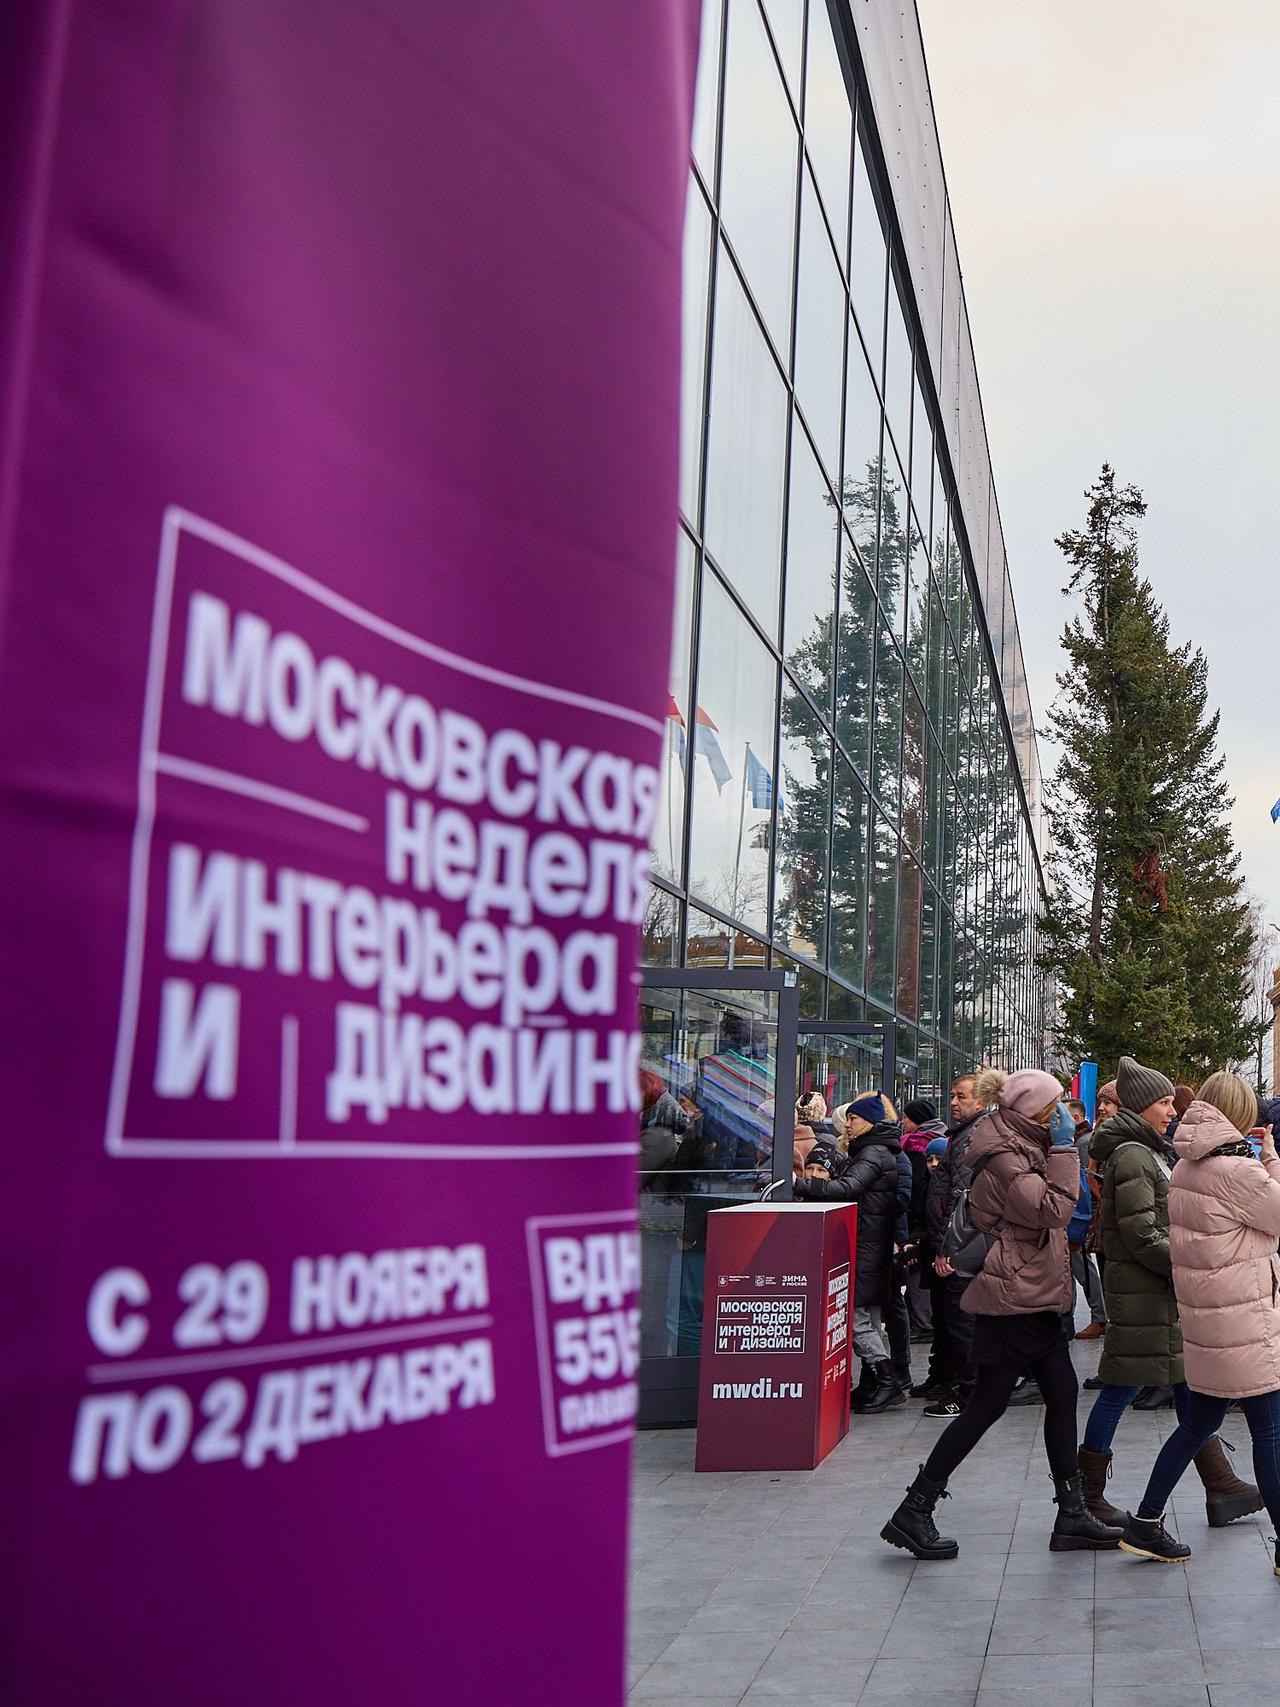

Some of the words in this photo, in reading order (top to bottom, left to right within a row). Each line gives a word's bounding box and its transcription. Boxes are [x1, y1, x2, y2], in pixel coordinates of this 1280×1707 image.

[164, 843, 619, 1030] интерьера
[782, 1275, 808, 1283] ЗИМА
[86, 1265, 151, 1358] С
[172, 1259, 270, 1350] 29
[289, 1243, 489, 1335] НОЯБРЯ
[720, 1301, 803, 1313] московская
[752, 1312, 803, 1326] неделя
[719, 1325, 791, 1338] интерьера
[718, 1337, 728, 1349] и
[740, 1336, 801, 1350] дизайна
[712, 1377, 803, 1399] mwdi.ru
[68, 1384, 193, 1485] ПО
[192, 1377, 249, 1465] 2
[242, 1338, 496, 1470] ДЕКАБРЯ
